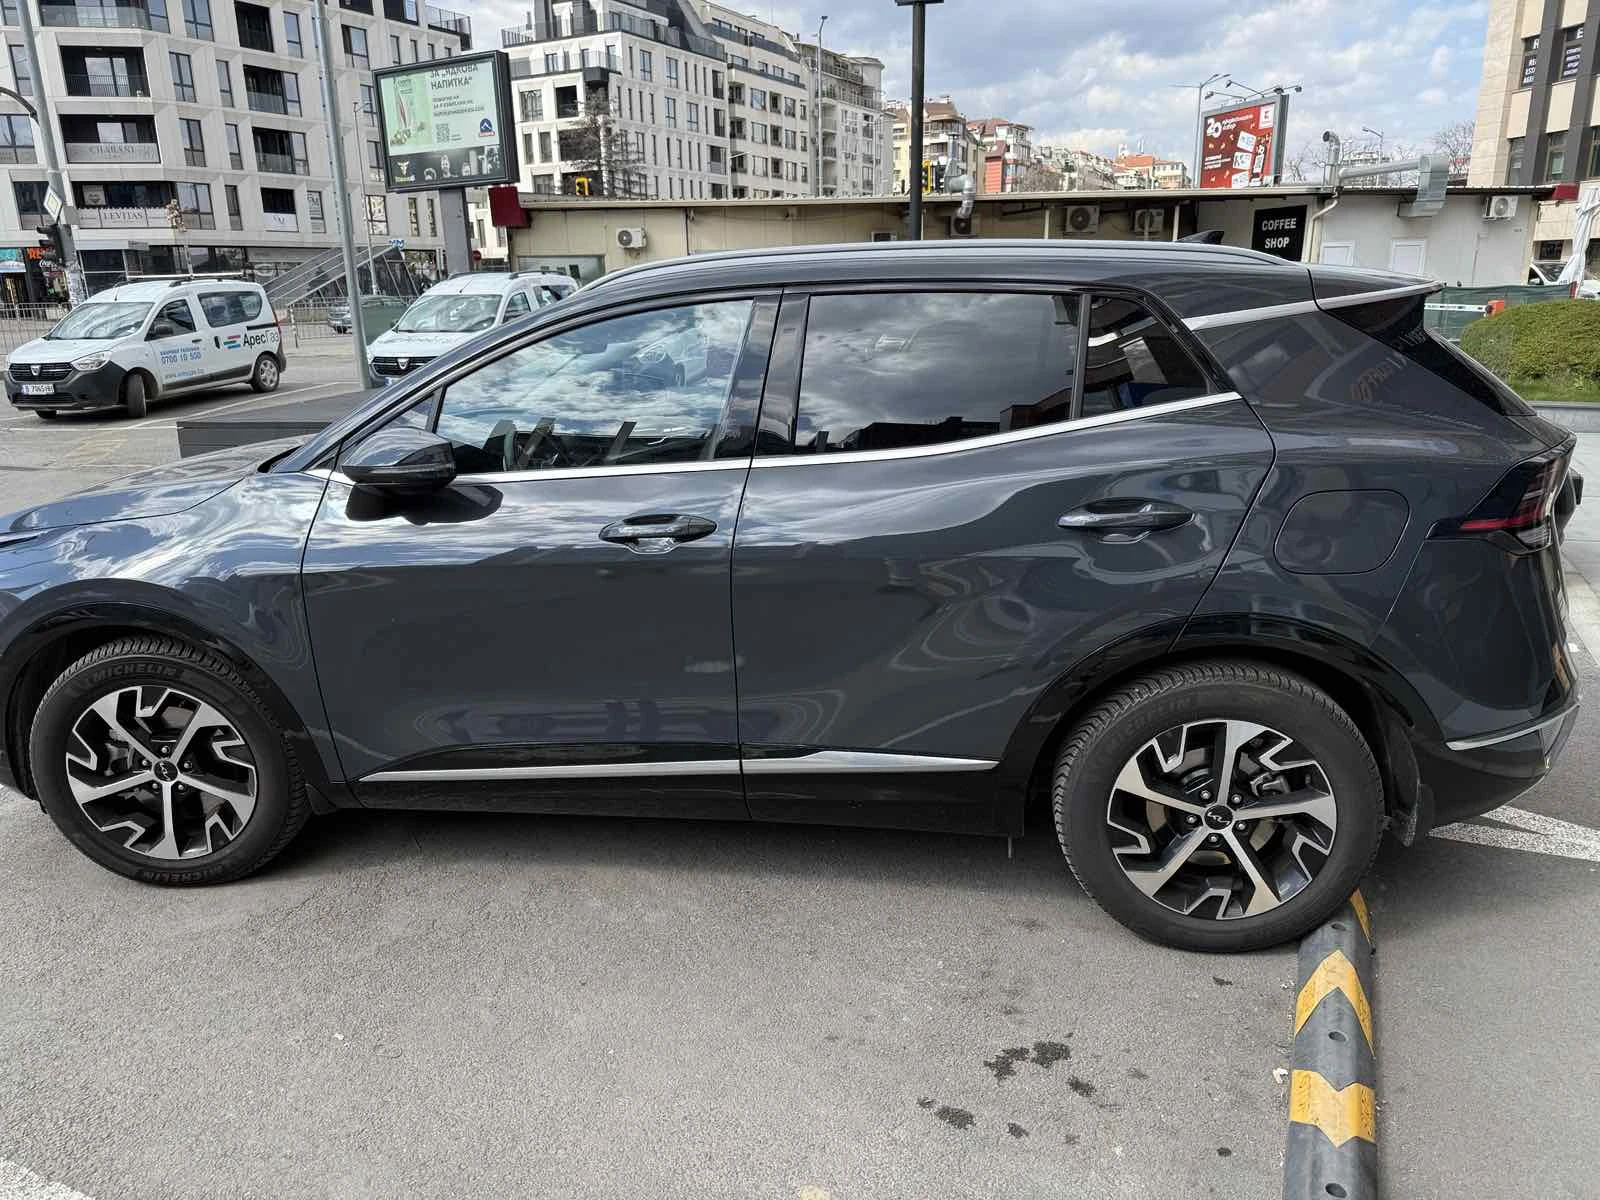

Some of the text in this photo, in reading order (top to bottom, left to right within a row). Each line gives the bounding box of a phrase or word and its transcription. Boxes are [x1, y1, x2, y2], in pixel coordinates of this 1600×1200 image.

[1262, 218, 1297, 231] COFFEE
[1265, 237, 1290, 249] SHOP
[161, 354, 178, 365] 0700
[94, 663, 177, 680] MICHELIN
